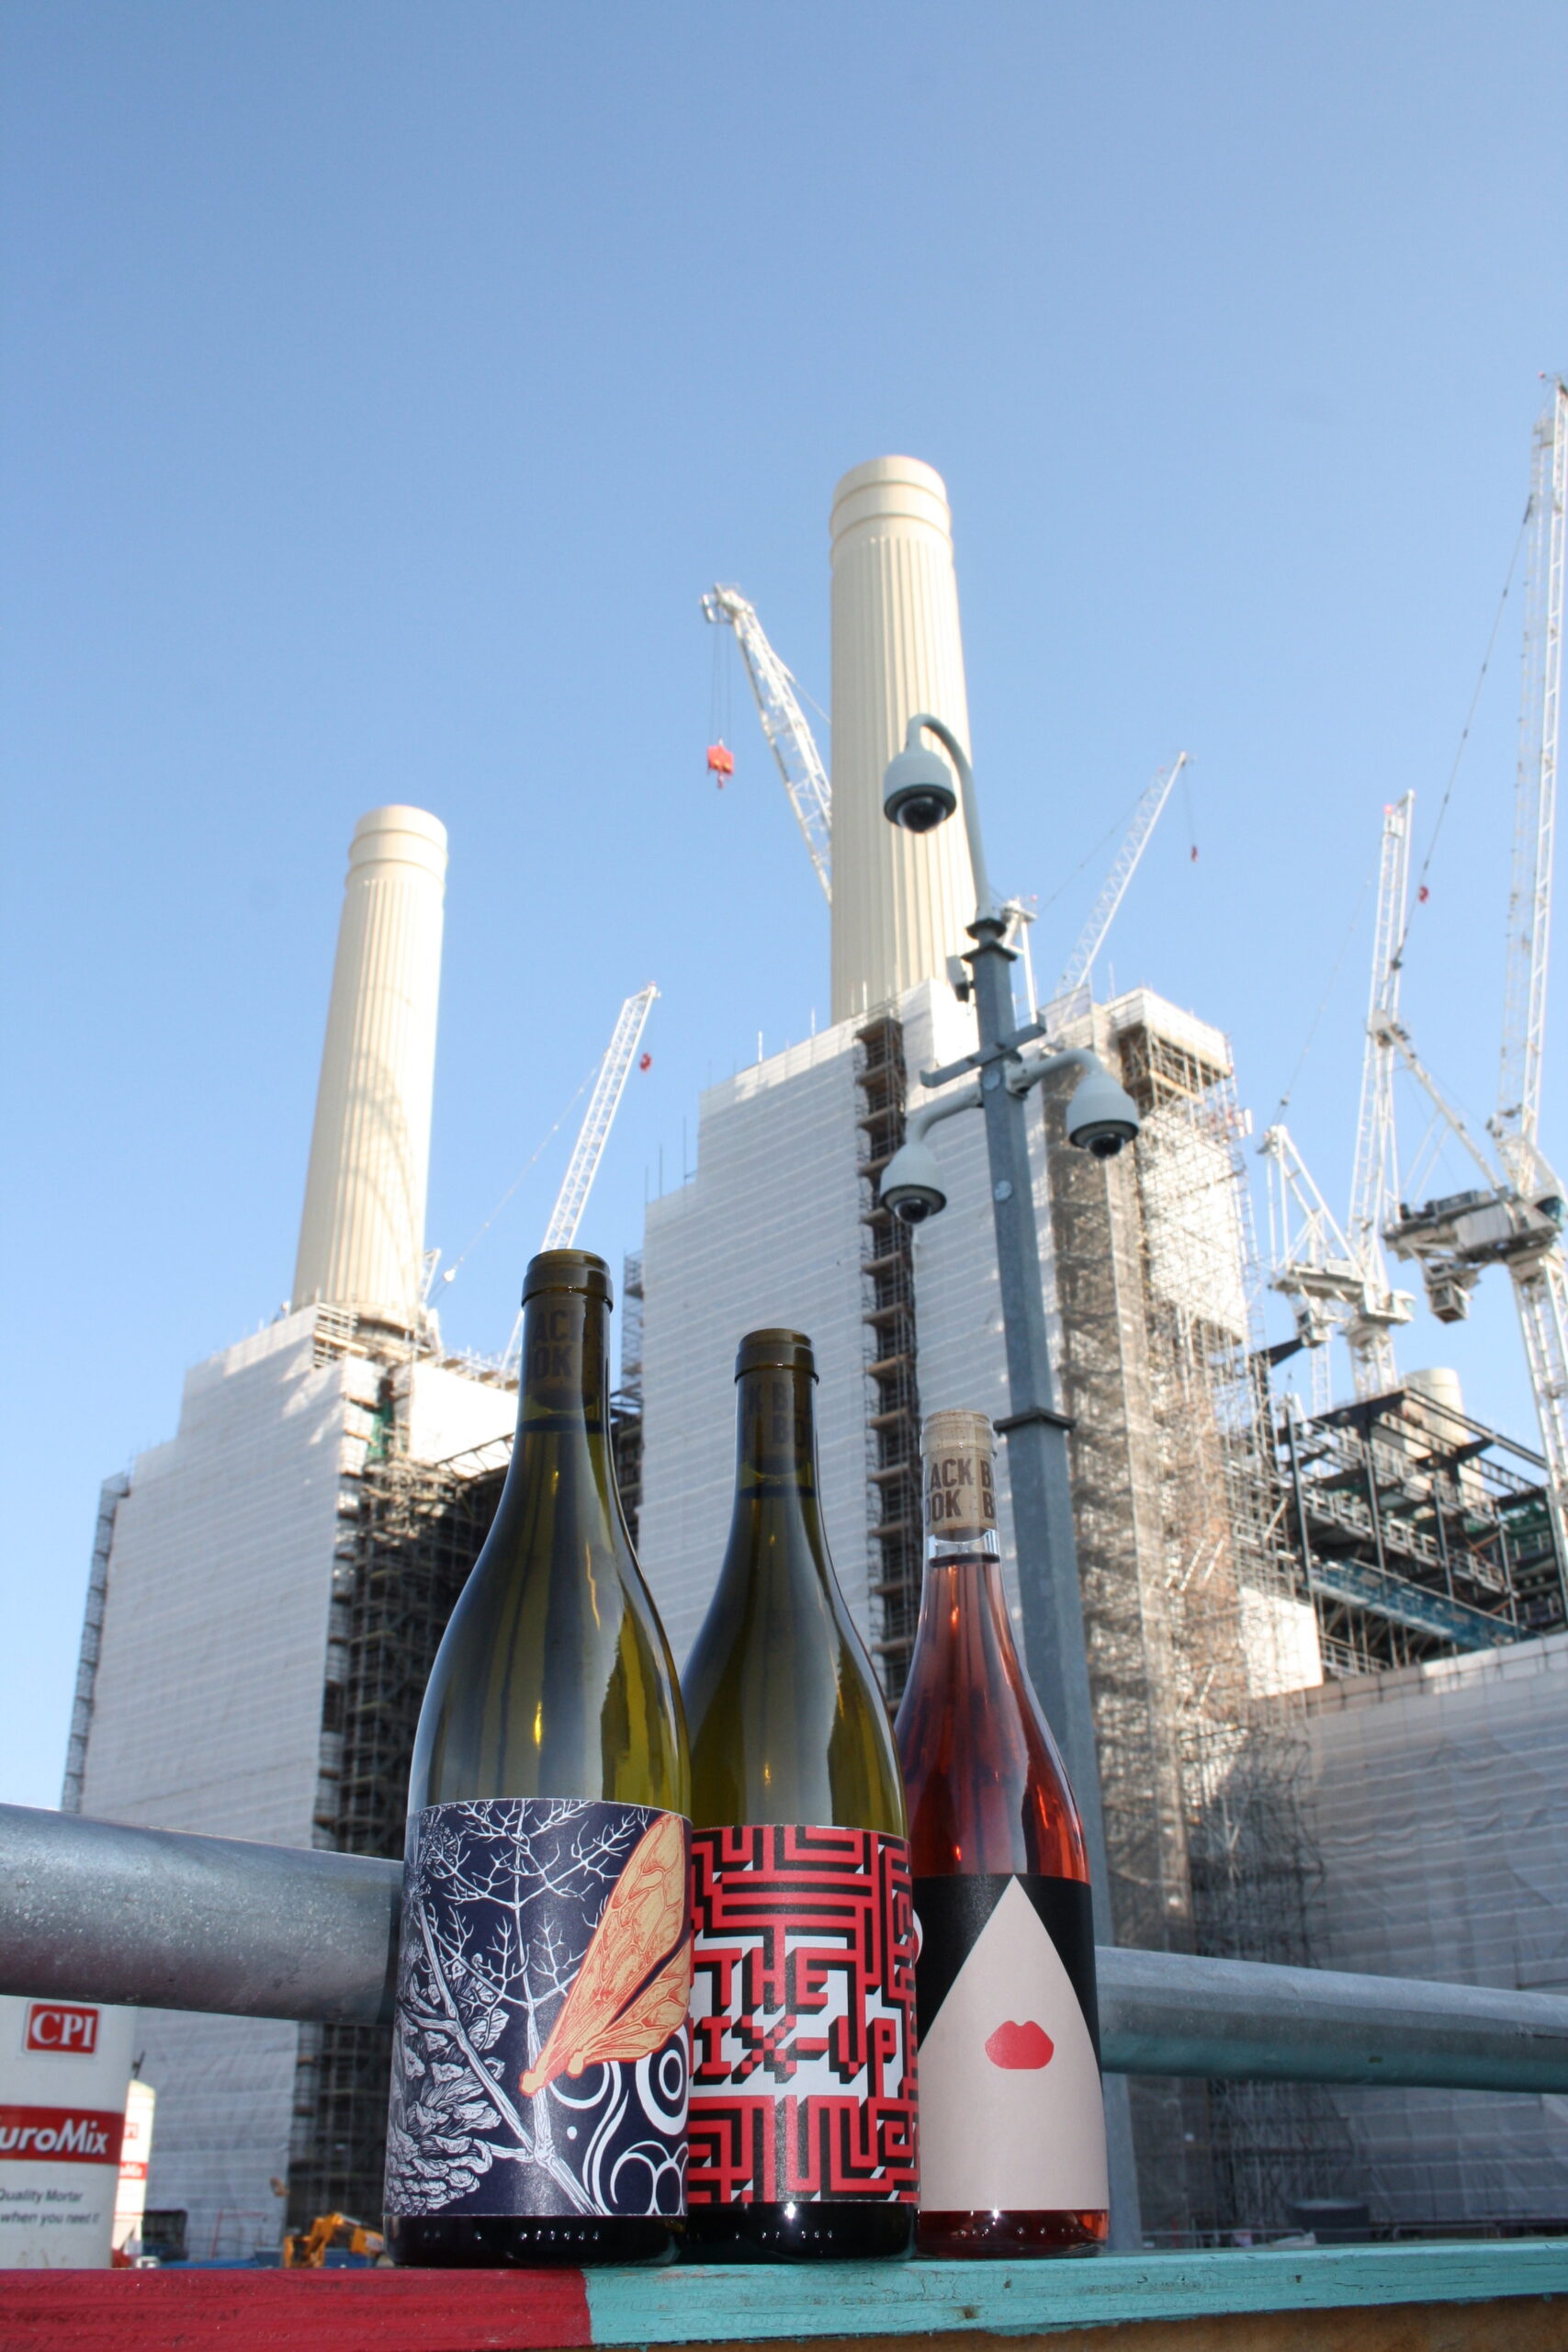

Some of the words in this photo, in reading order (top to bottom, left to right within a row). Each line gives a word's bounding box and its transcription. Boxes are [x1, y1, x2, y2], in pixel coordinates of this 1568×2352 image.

[31, 2010, 96, 2048] CPI
[1, 2211, 39, 2223] when
[40, 2213, 63, 2227] you
